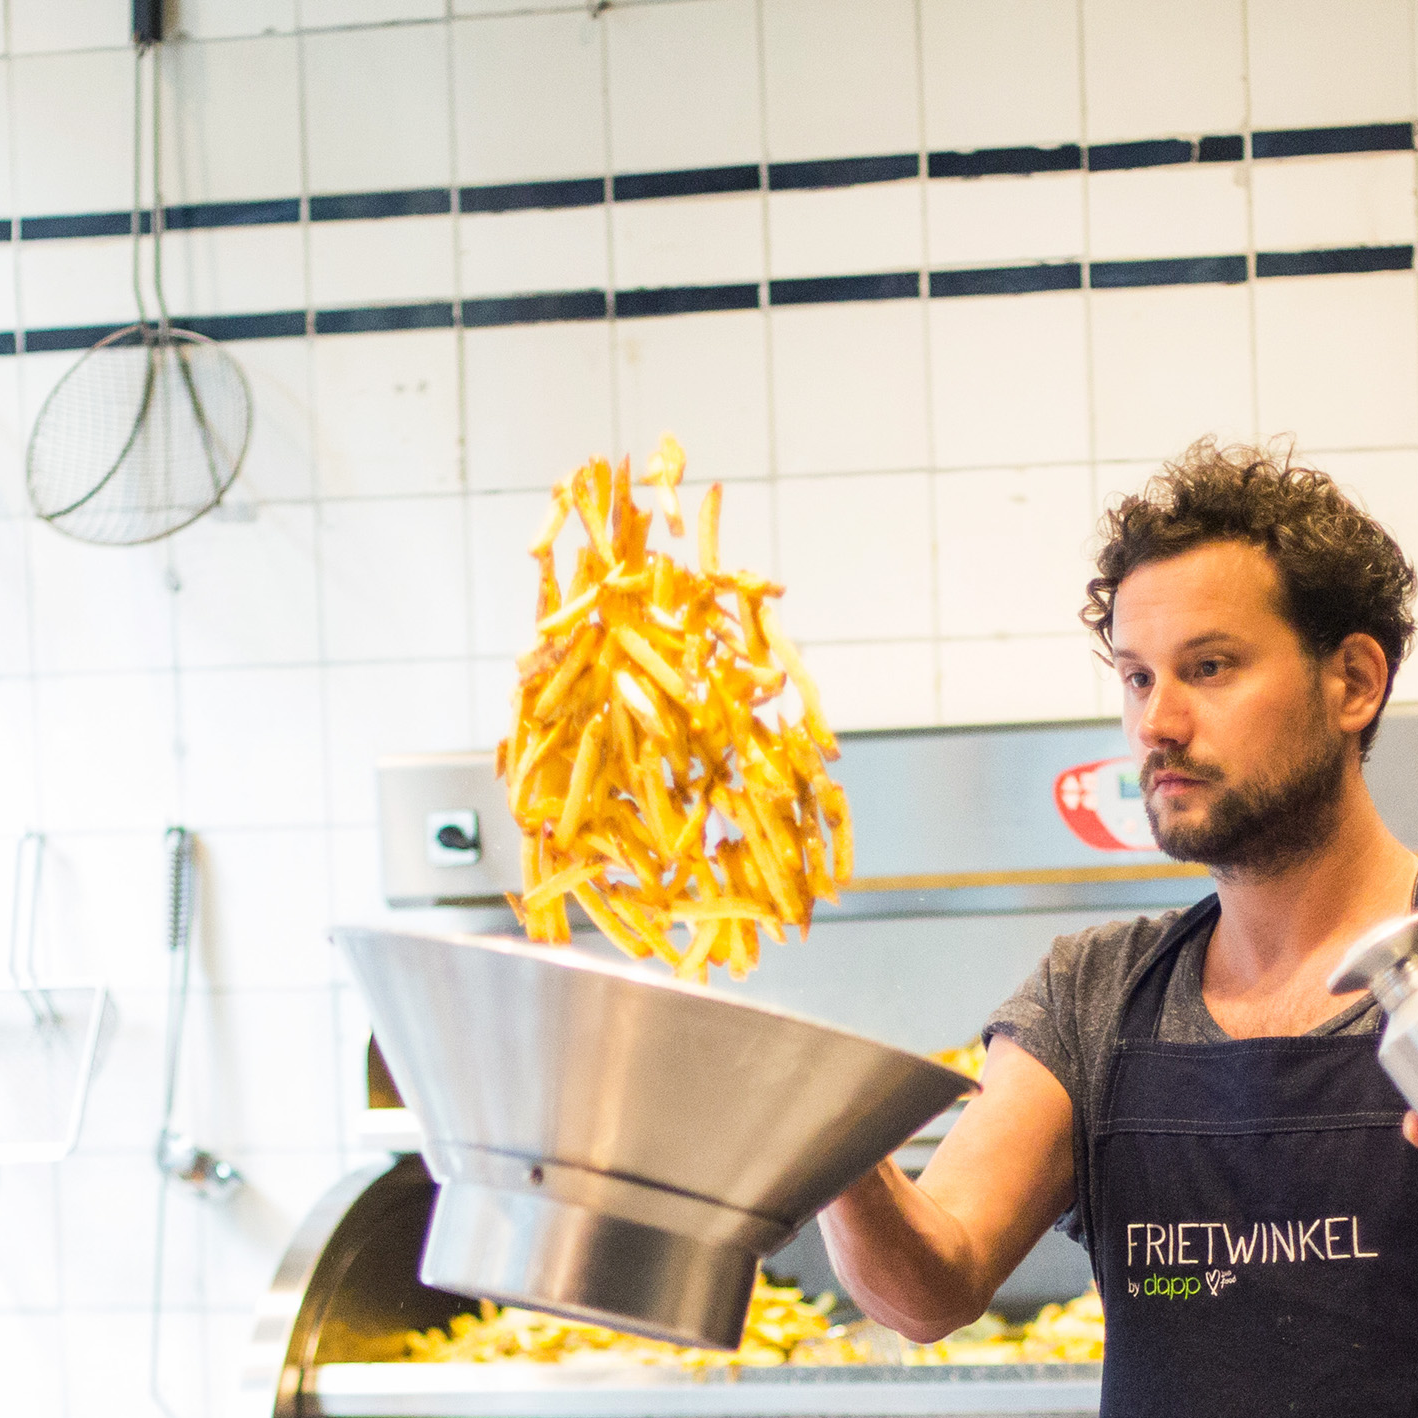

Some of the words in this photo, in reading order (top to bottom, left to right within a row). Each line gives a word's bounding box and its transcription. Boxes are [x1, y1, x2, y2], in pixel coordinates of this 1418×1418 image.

[1127, 1216, 1378, 1266] FRIETWINKEL
[1127, 1278, 1140, 1297] by
[1144, 1273, 1201, 1300] dapp
